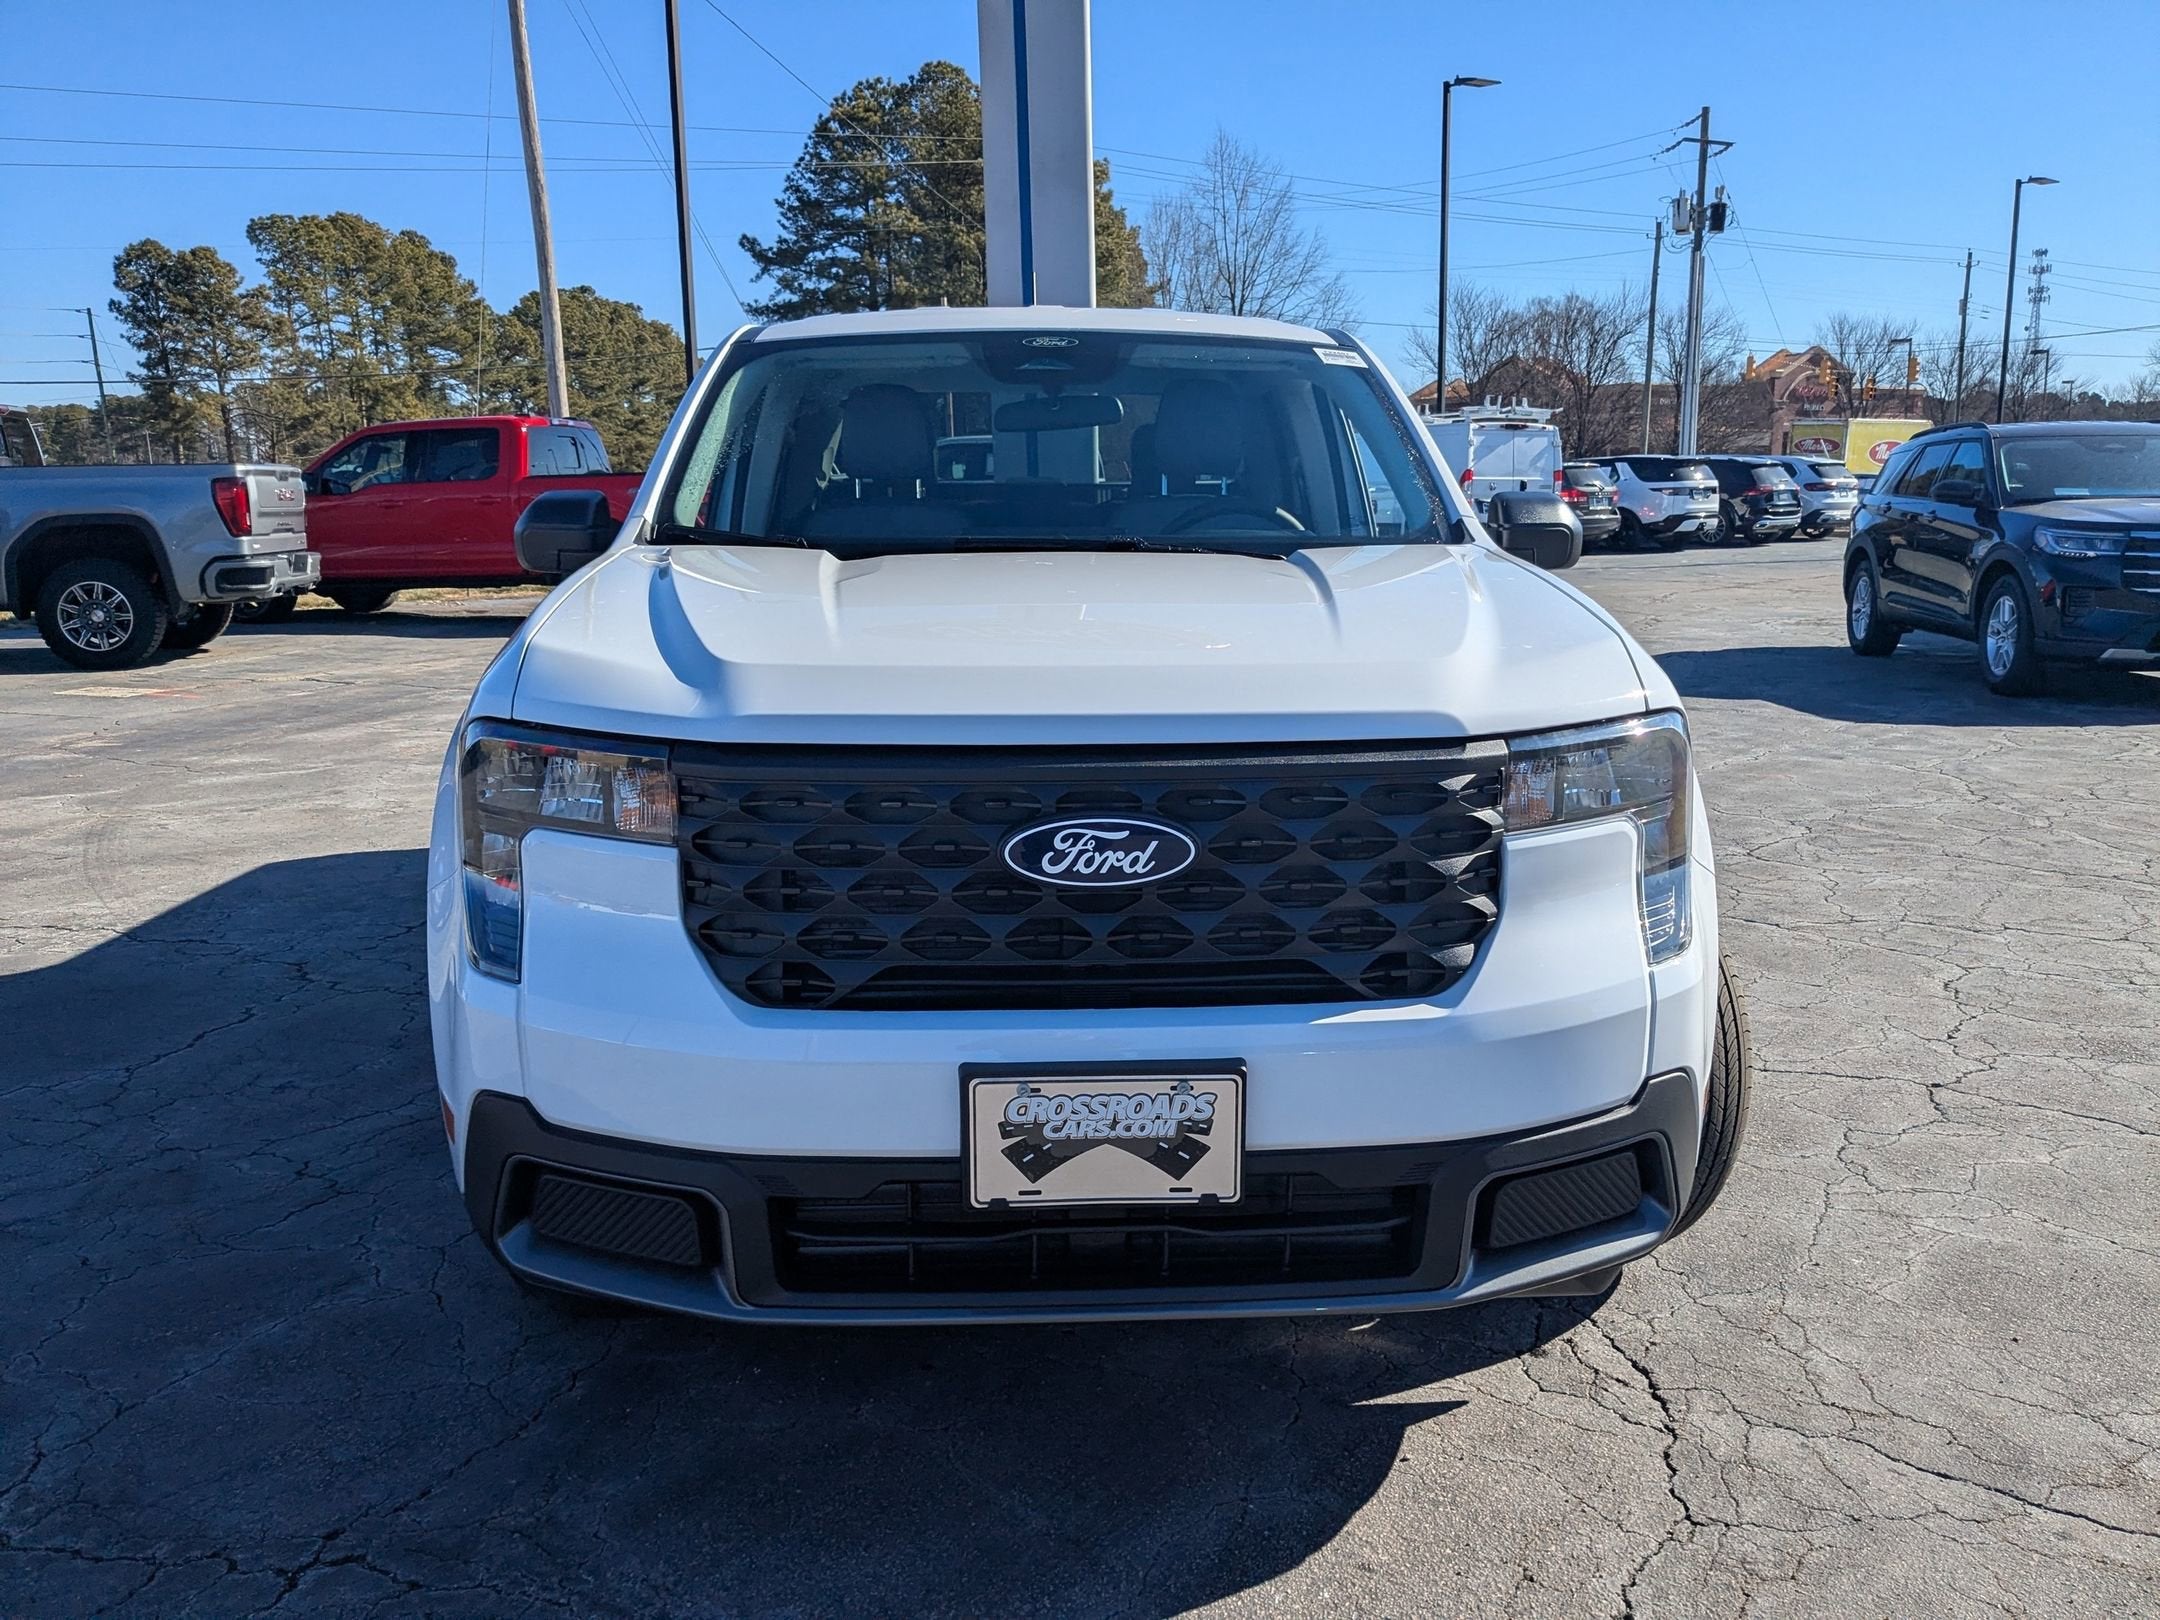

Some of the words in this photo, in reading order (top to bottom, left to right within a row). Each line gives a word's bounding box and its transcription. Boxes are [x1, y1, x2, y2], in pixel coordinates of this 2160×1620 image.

[1042, 828, 1159, 874] Ford
[1005, 1093, 1218, 1123] CROSSROADS
[1043, 1120, 1178, 1139] CARS.COM
